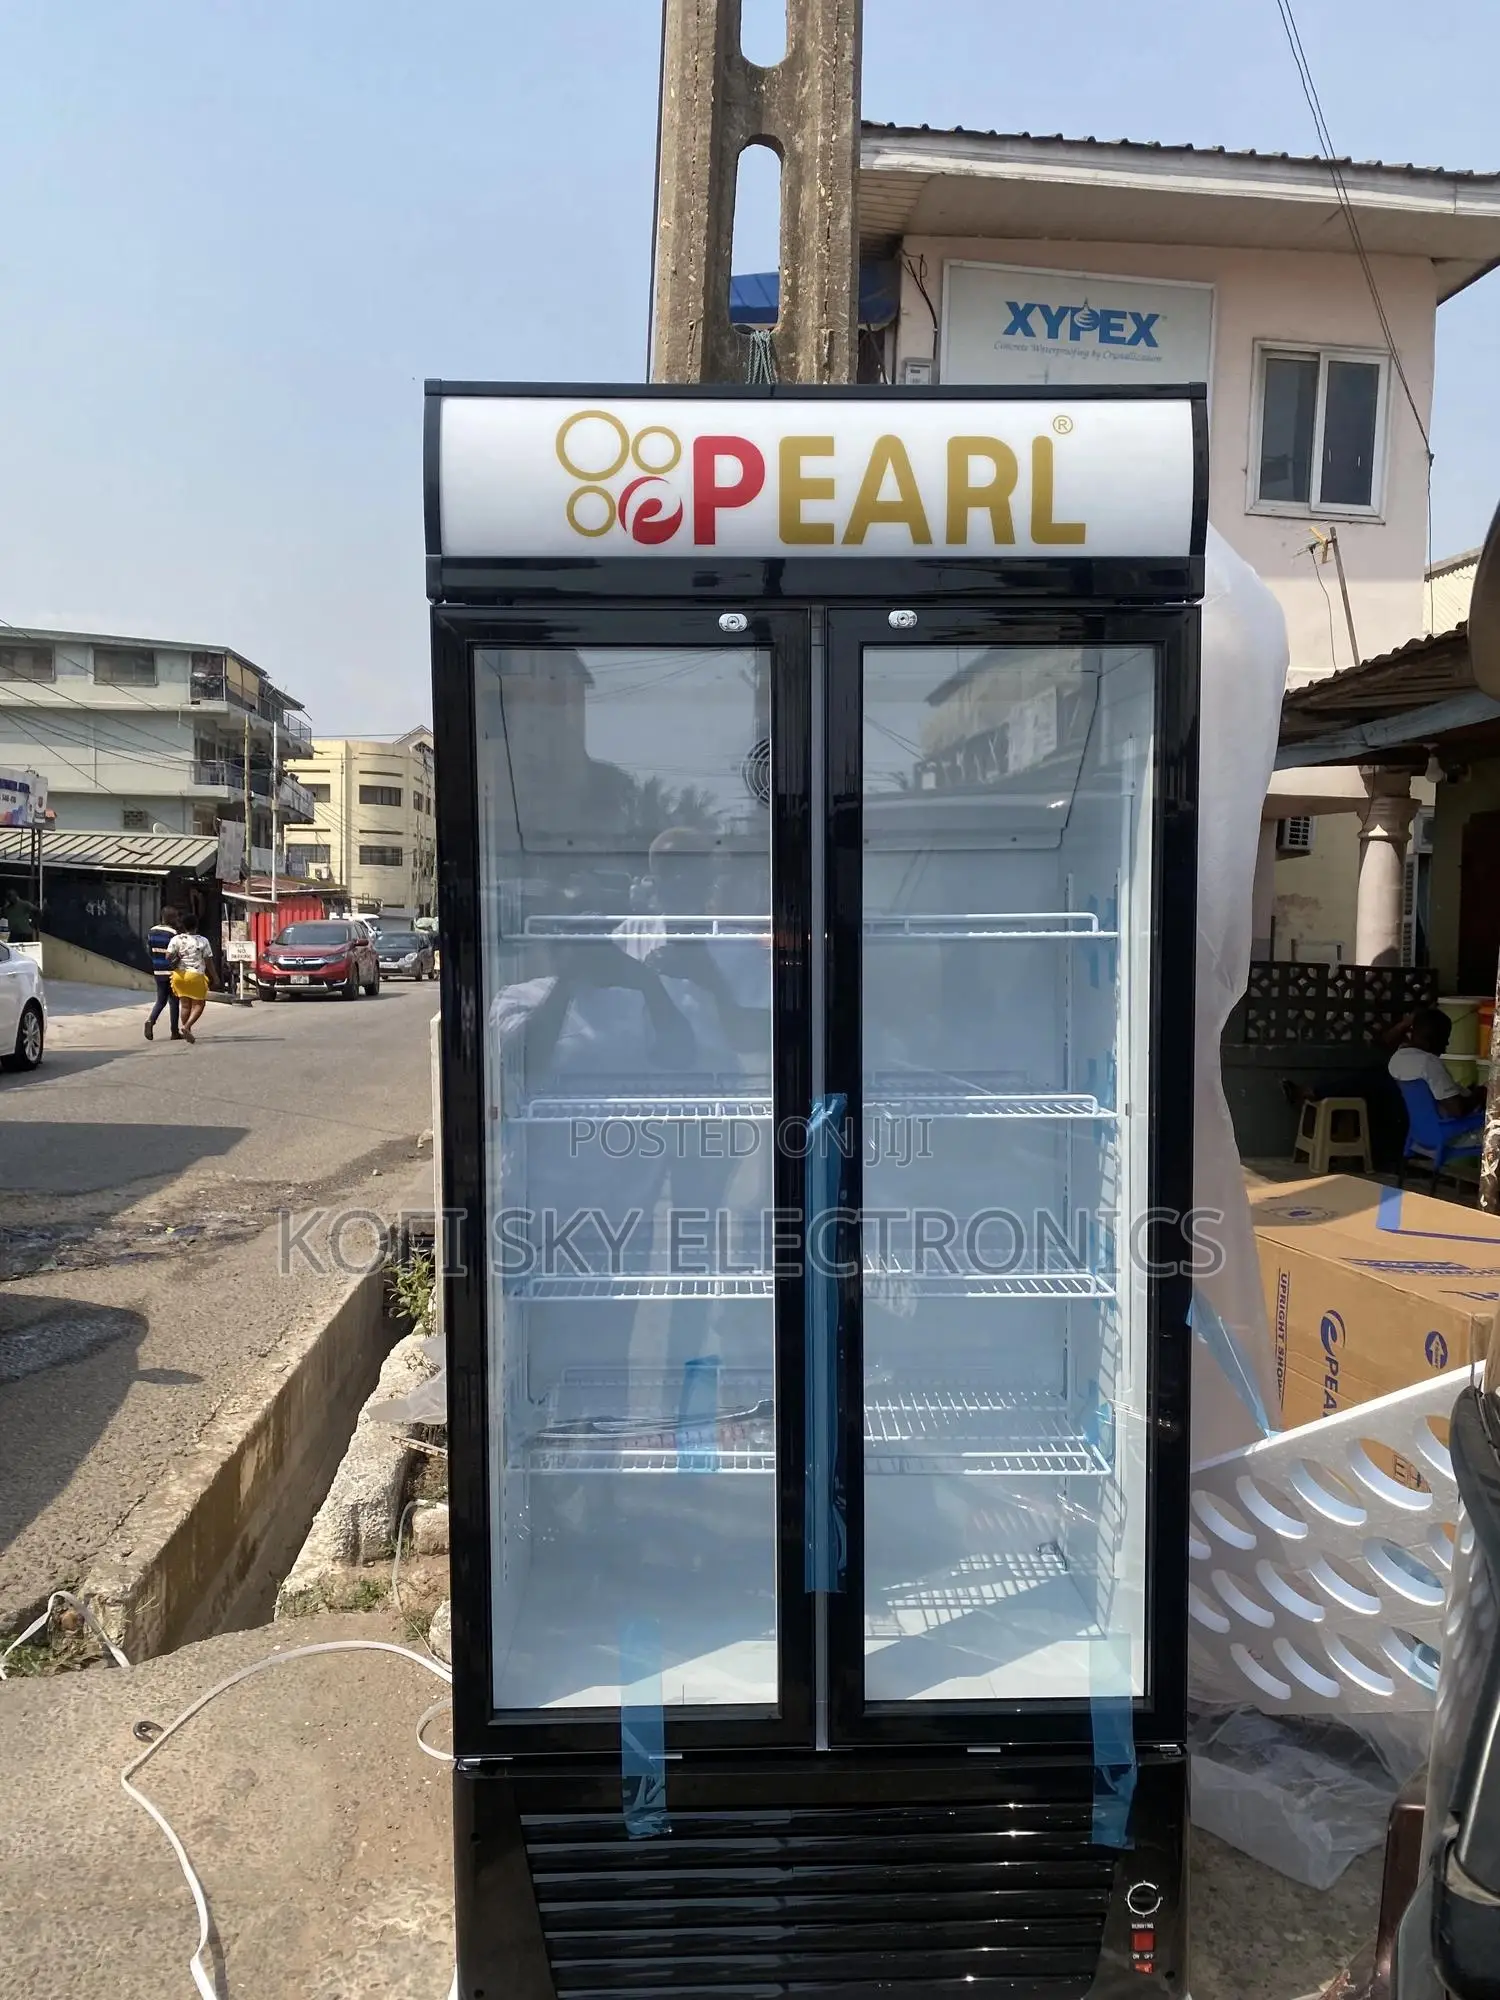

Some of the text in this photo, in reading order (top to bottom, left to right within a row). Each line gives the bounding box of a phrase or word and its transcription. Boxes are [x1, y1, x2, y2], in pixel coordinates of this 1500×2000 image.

[1002, 301, 1160, 347] XYPEX
[692, 434, 1087, 546] PEARL
[1276, 1273, 1287, 1401] UPRIGHT SHOW
[1323, 1356, 1340, 1418] PEA
